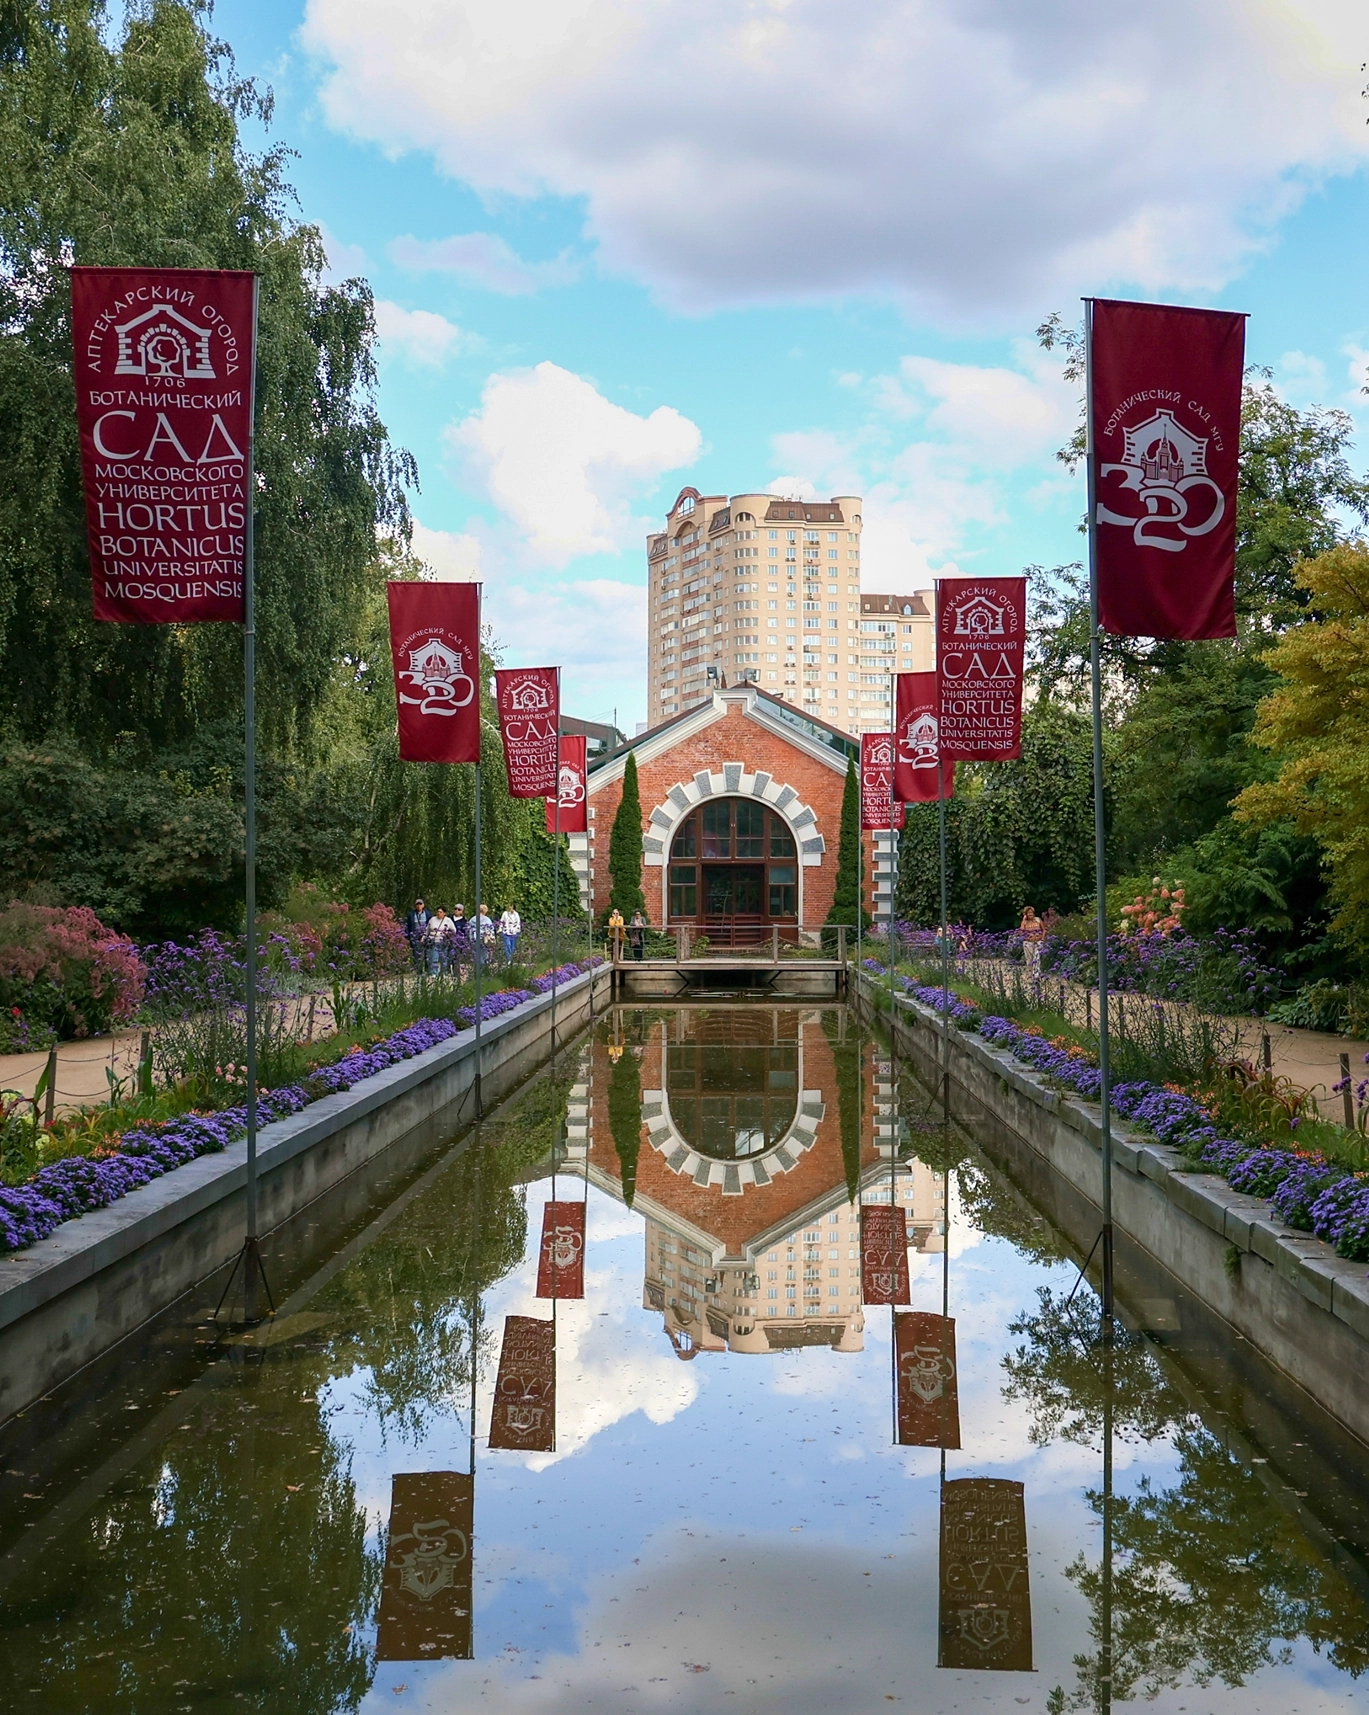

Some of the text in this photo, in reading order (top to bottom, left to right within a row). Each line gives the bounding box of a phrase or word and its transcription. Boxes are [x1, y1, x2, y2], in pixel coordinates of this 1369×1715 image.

[88, 285, 239, 376] АПТЕКАРСКИЙ ОГОРОД
[144, 376, 186, 388] 1706
[89, 390, 242, 409] БОТАНИЧЕСКИЙ
[1103, 389, 1224, 452] БОТАНИЧЕСКИЙ САД МГУ
[92, 410, 245, 466] САД
[95, 464, 244, 482] МОСКОВСКОГО
[95, 482, 244, 501] УНИВЕРСИТЕТА
[97, 502, 245, 532] HORTUS
[99, 534, 244, 558] BOTANICUS
[102, 560, 243, 577] UNIVERSITATIS
[104, 580, 242, 603] MOSQUENSIS
[942, 587, 1018, 634] АПТЕКАРСКИЙ ОГОРОД
[942, 641, 1017, 651] БОТАНИЧЕСКИЙ
[942, 652, 1017, 680] САД
[942, 680, 1016, 689] МОСКОВСКОГО
[942, 689, 1015, 699] УНИВЕРСИТЕТА
[942, 700, 1015, 715] HORTUS
[506, 720, 557, 741] САД
[940, 716, 1014, 728] BOTANICUS
[940, 729, 1013, 738] UNIVERSITATIS
[940, 740, 1013, 751] MOSQUENSIS
[509, 751, 557, 766] HORTUS
[864, 772, 891, 787] СА
